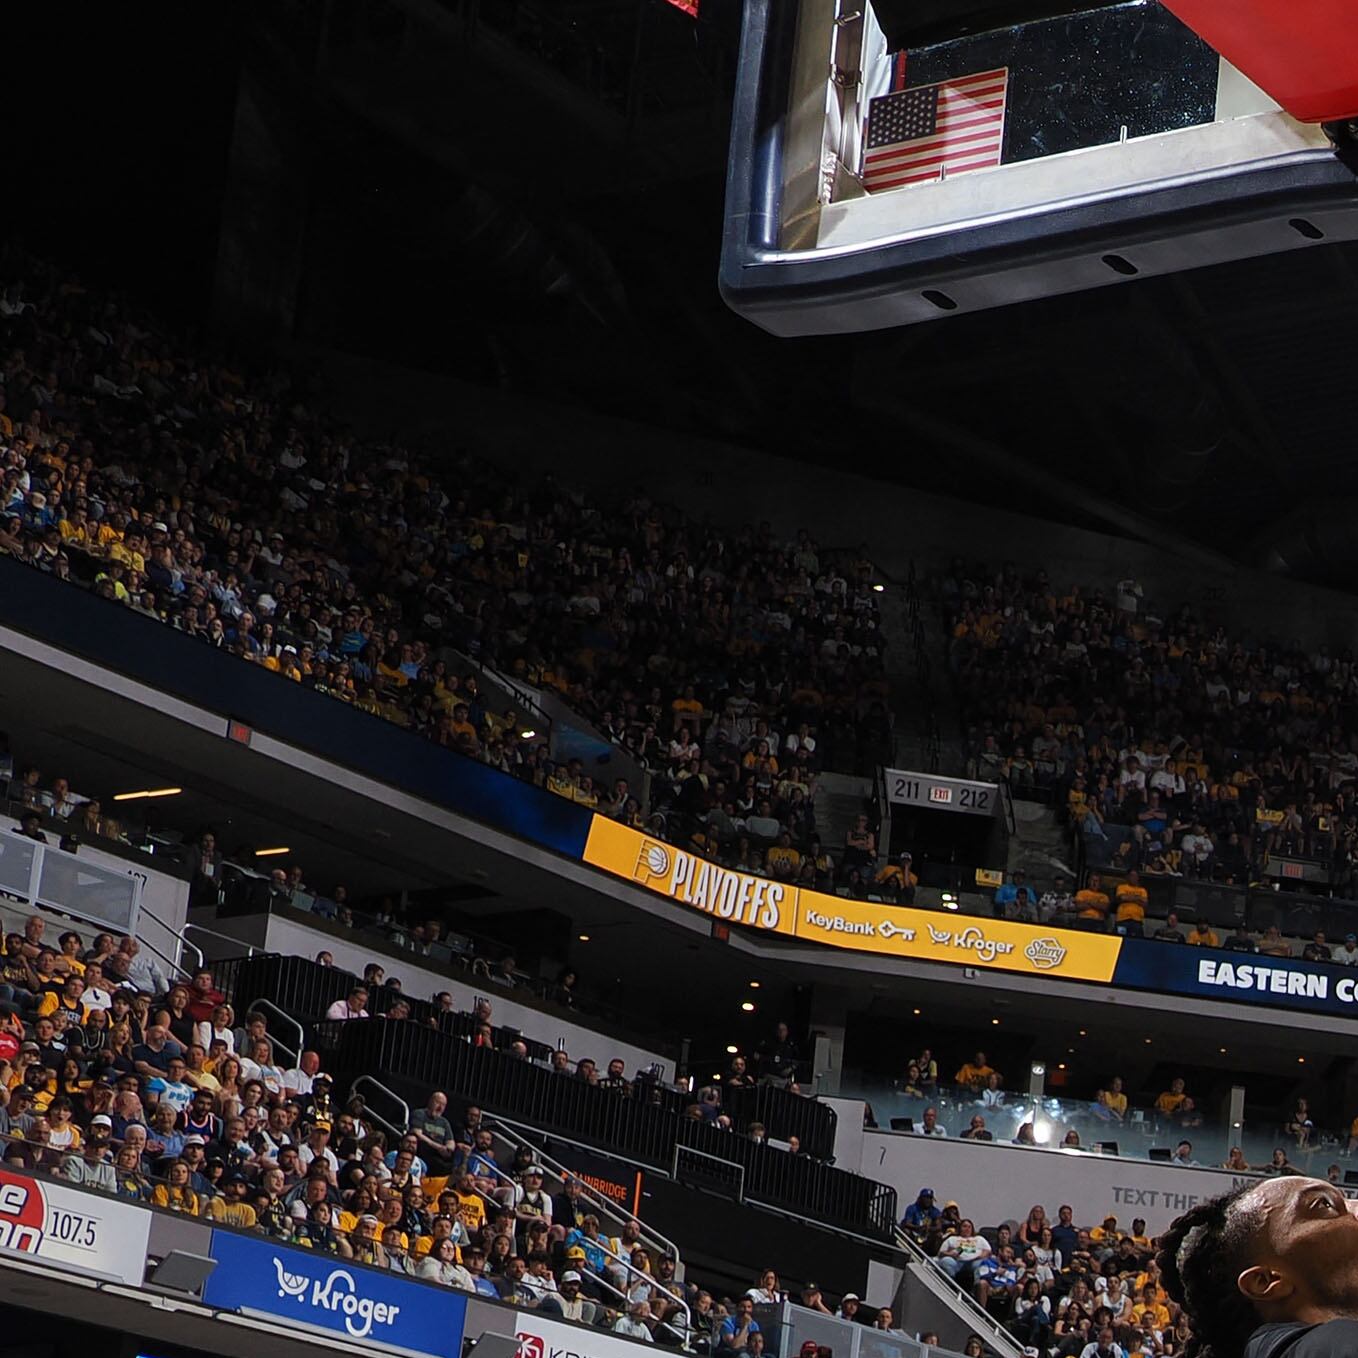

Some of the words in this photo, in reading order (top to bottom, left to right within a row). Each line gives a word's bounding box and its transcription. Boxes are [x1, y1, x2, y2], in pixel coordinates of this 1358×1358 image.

[895, 779, 919, 799] 211
[960, 788, 988, 809] 212
[668, 852, 785, 930] PLAYOFFS
[805, 908, 875, 938] KeyBank
[953, 925, 1014, 961] Kroger
[1026, 938, 1067, 965] Starry
[1198, 959, 1328, 999] EASTERN
[1112, 1186, 1160, 1208] TEXT
[1163, 1191, 1199, 1210] THE
[50, 1210, 97, 1247] 107.5
[311, 1269, 400, 1337] Kroger
